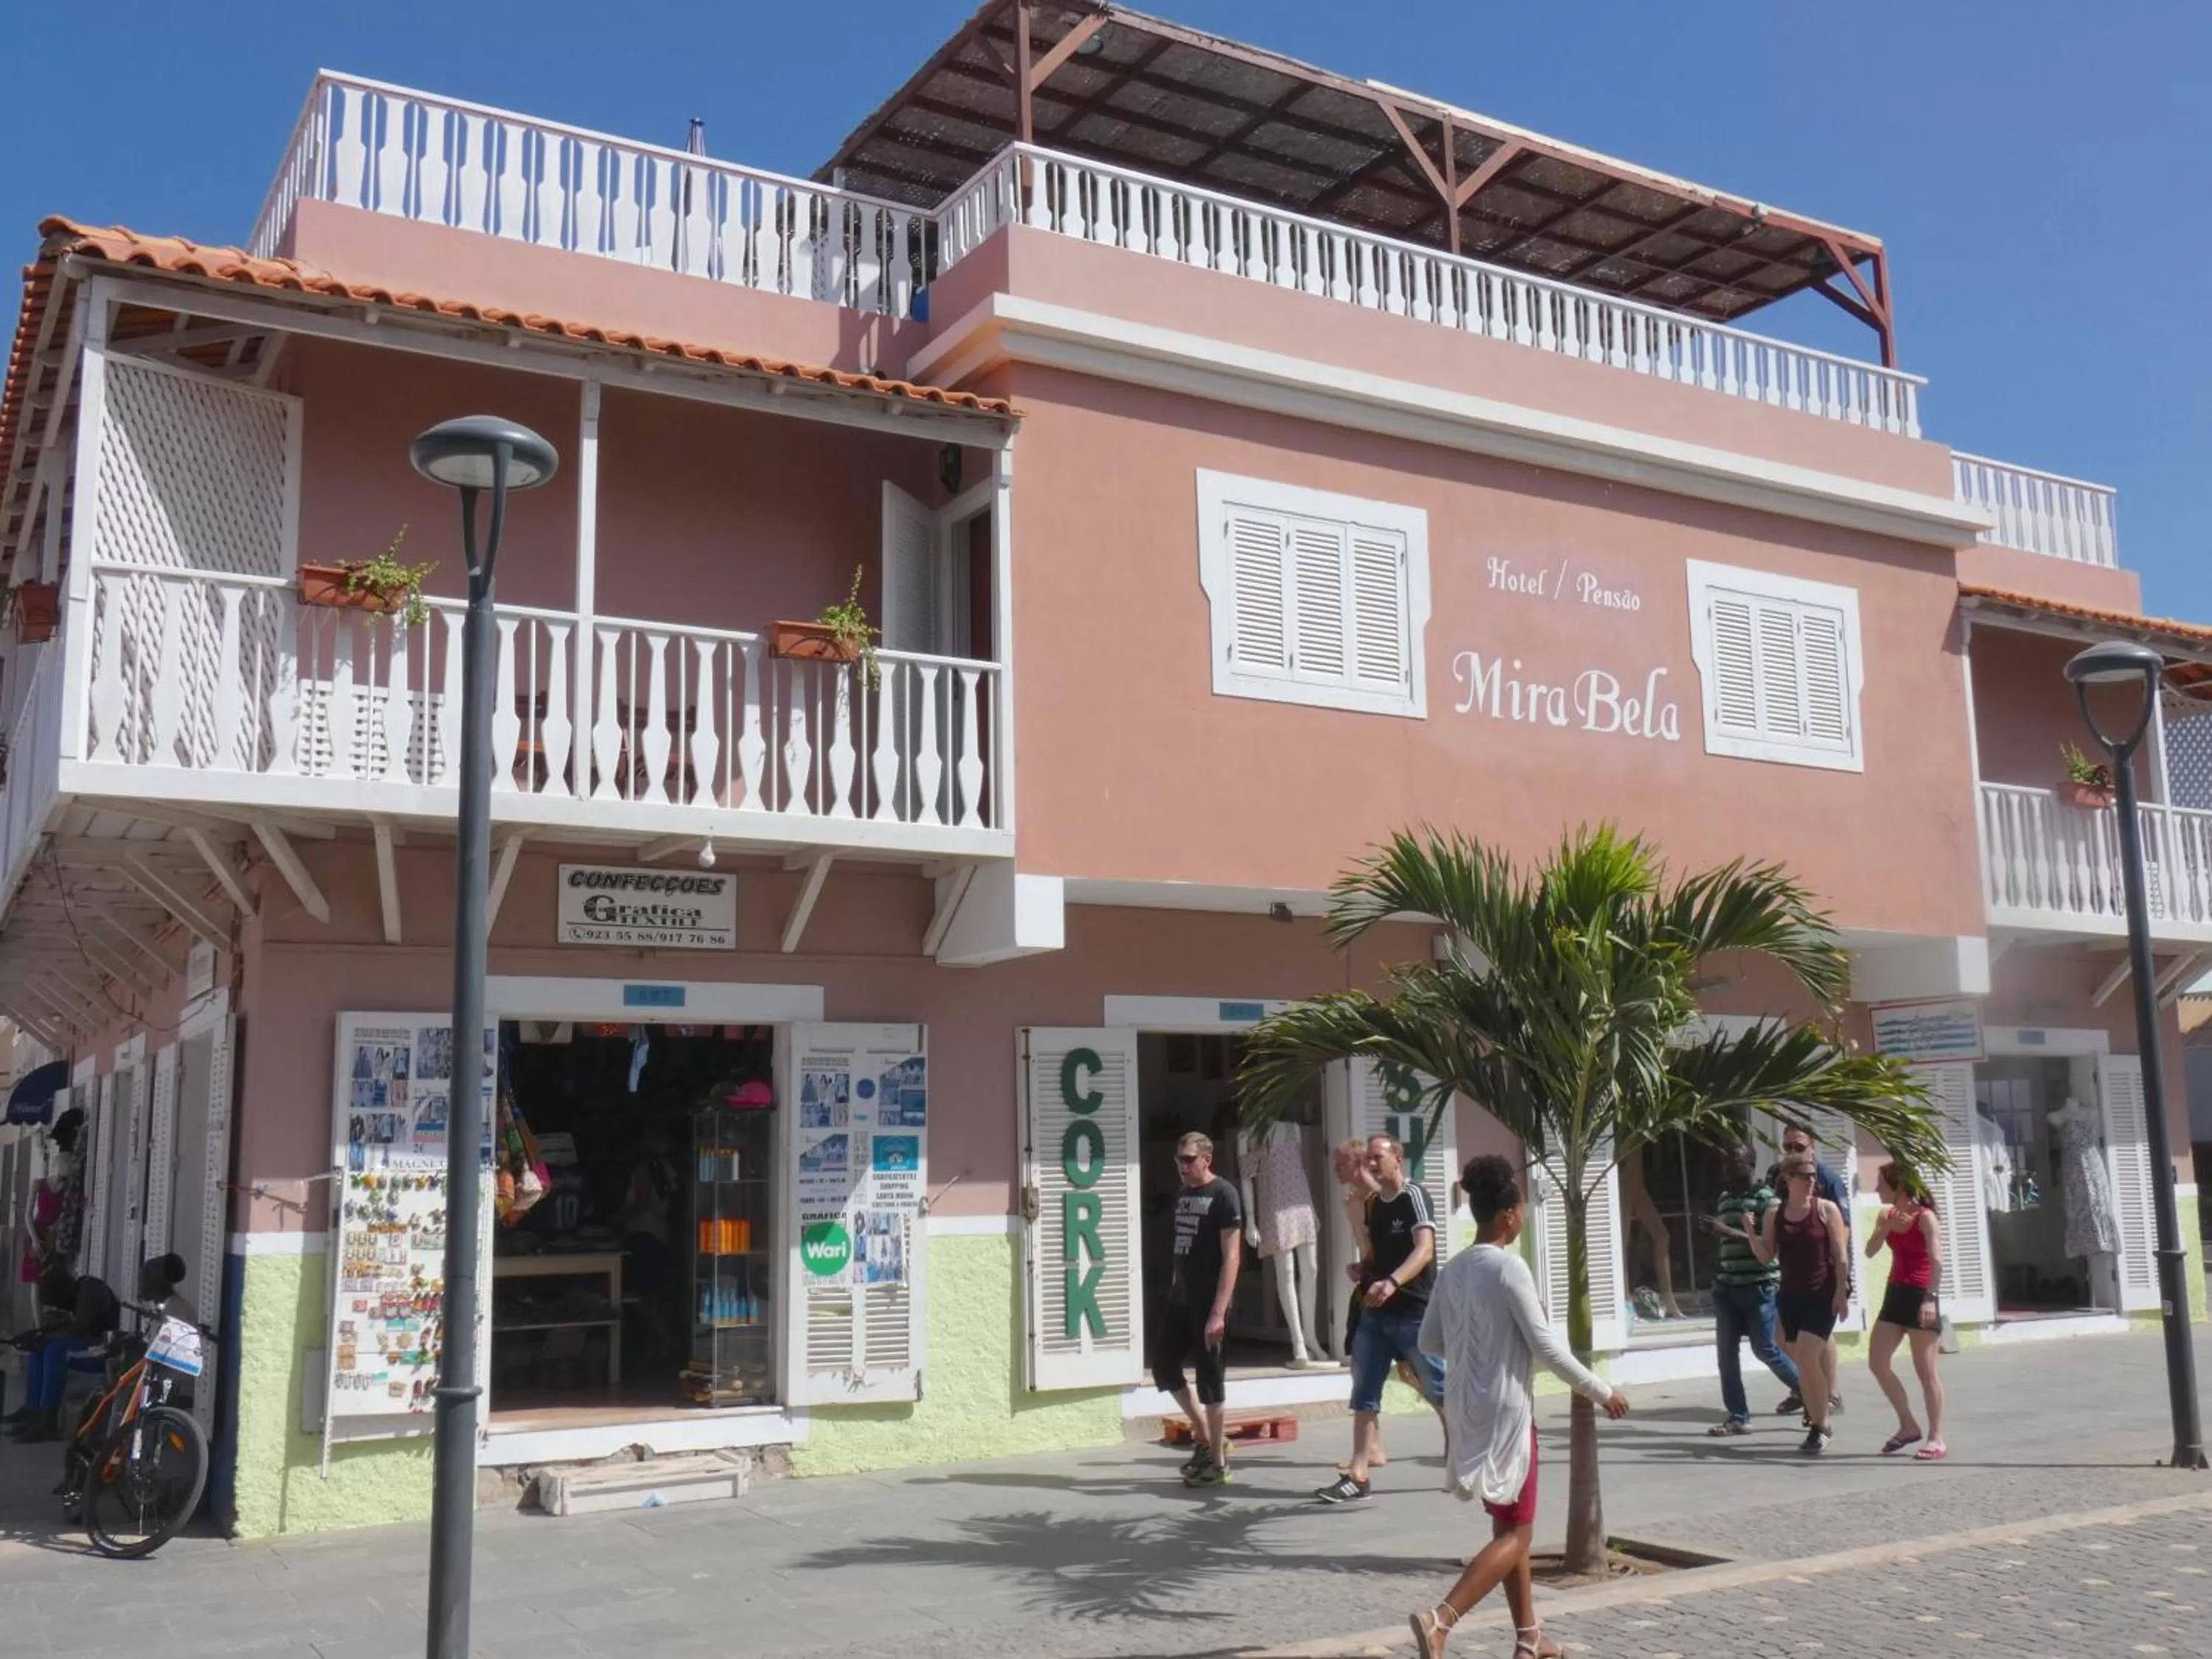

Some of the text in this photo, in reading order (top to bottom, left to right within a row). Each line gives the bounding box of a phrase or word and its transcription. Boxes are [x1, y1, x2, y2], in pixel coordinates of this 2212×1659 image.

[1487, 557, 1641, 611] Hotel / Pensão
[1060, 1047, 1106, 1340] CORK
[807, 1242, 846, 1258] Wari
